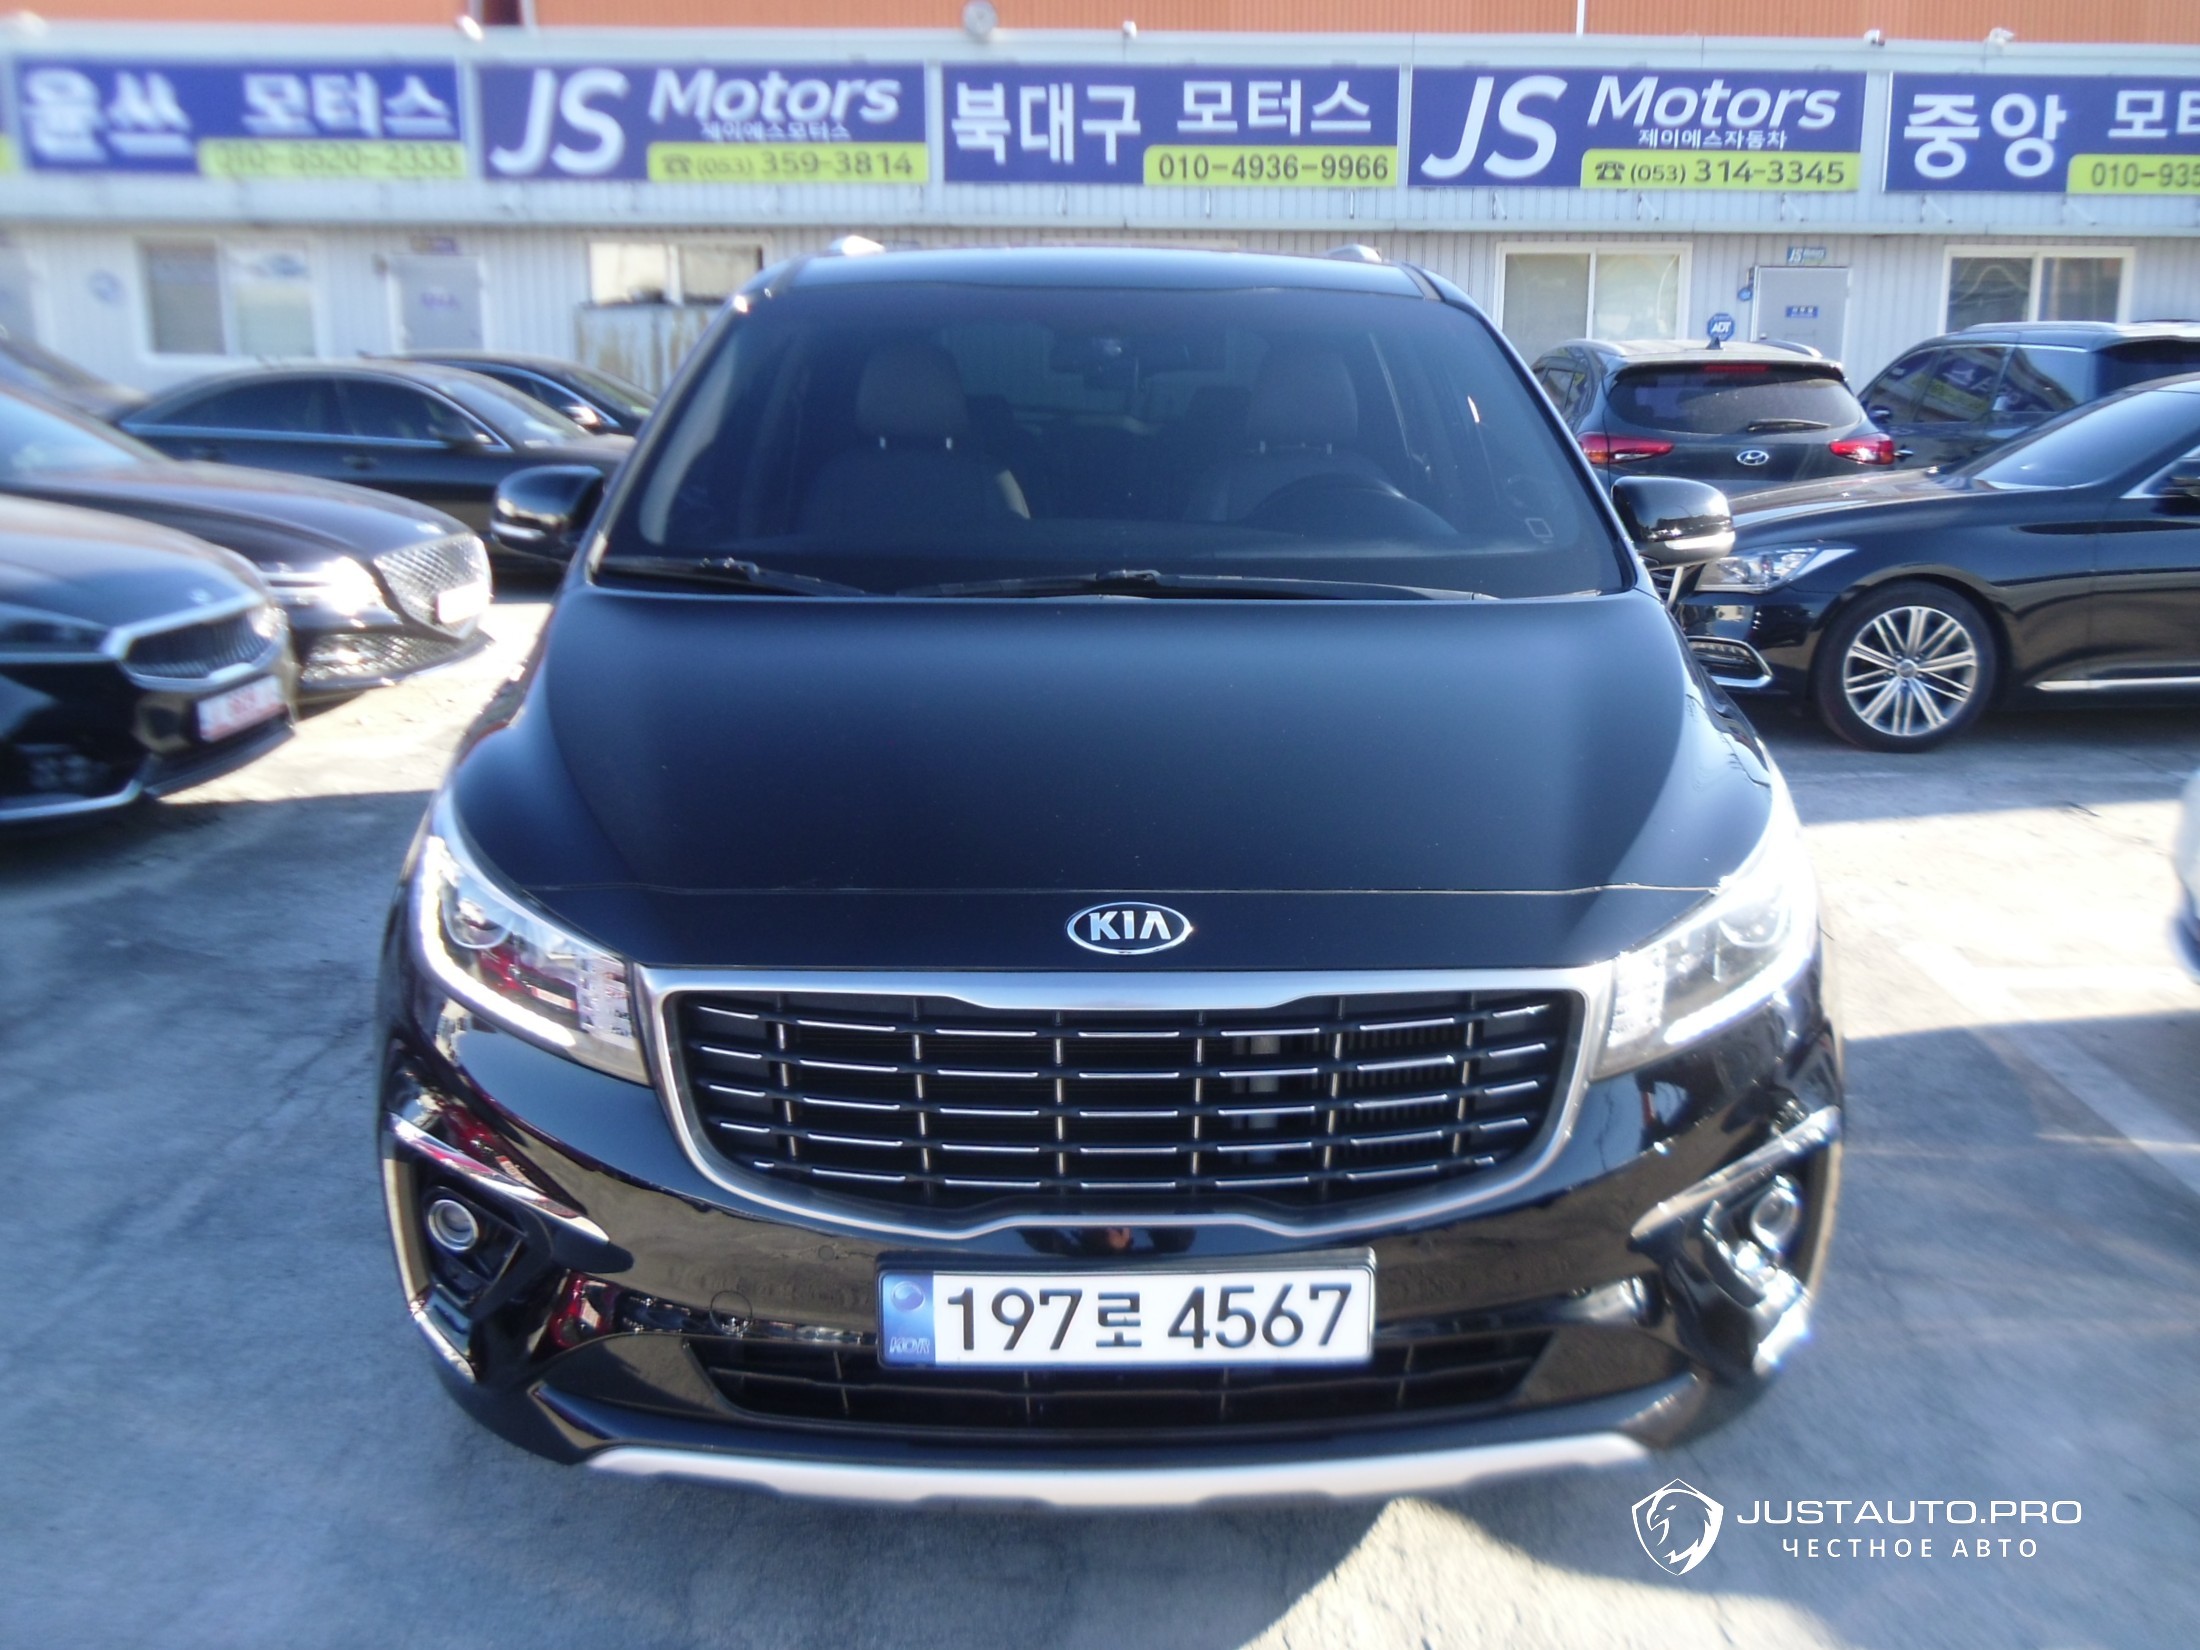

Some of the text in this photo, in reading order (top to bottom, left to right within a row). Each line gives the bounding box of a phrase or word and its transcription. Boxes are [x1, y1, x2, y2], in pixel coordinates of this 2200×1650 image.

[241, 72, 458, 138] 모터스
[489, 67, 630, 176] JS
[647, 67, 902, 125] Motors
[951, 80, 1373, 165] 북대구 모터스
[1587, 75, 1842, 129] Motors
[1420, 75, 1569, 179] JS
[1638, 129, 1788, 150] 제이에스자동차
[1903, 92, 2067, 178] 중앙
[760, 150, 914, 175] 359-3814
[1158, 154, 1389, 180] 010-4936-9966
[1630, 159, 1846, 184] (053) 314-3345
[1710, 321, 1732, 333] ADT
[1089, 910, 1171, 941] KIA
[948, 1282, 1352, 1351] 197로 4567
[889, 1337, 930, 1353] KOR
